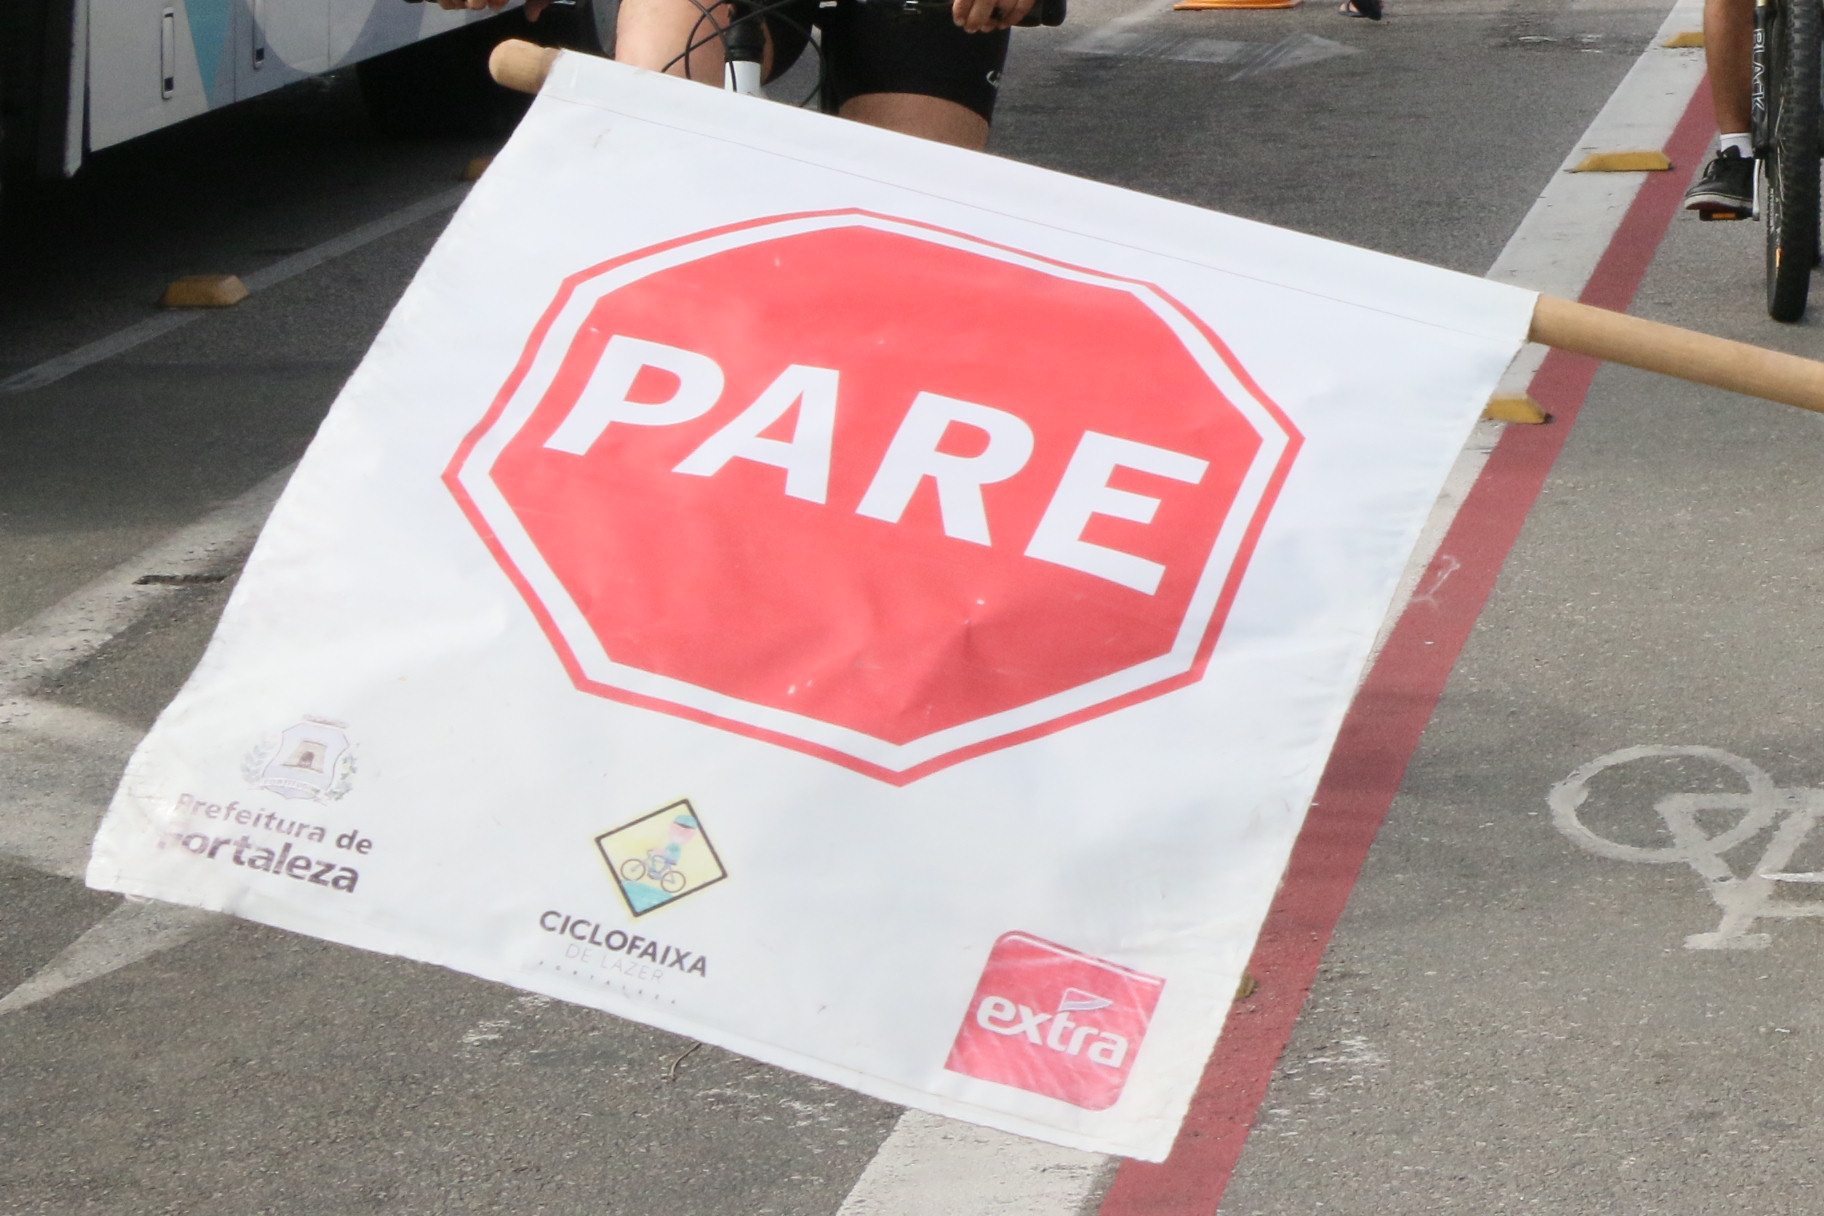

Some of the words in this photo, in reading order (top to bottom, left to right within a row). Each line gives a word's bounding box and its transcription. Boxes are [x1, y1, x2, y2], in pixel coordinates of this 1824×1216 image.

[1753, 27, 1766, 112] BLACK
[542, 333, 1210, 596] PARE
[335, 829, 374, 855] de
[539, 910, 708, 979] CICLOFAIXA
[565, 943, 594, 964] DE
[600, 954, 665, 984] LAZER
[976, 994, 1129, 1069] extra
